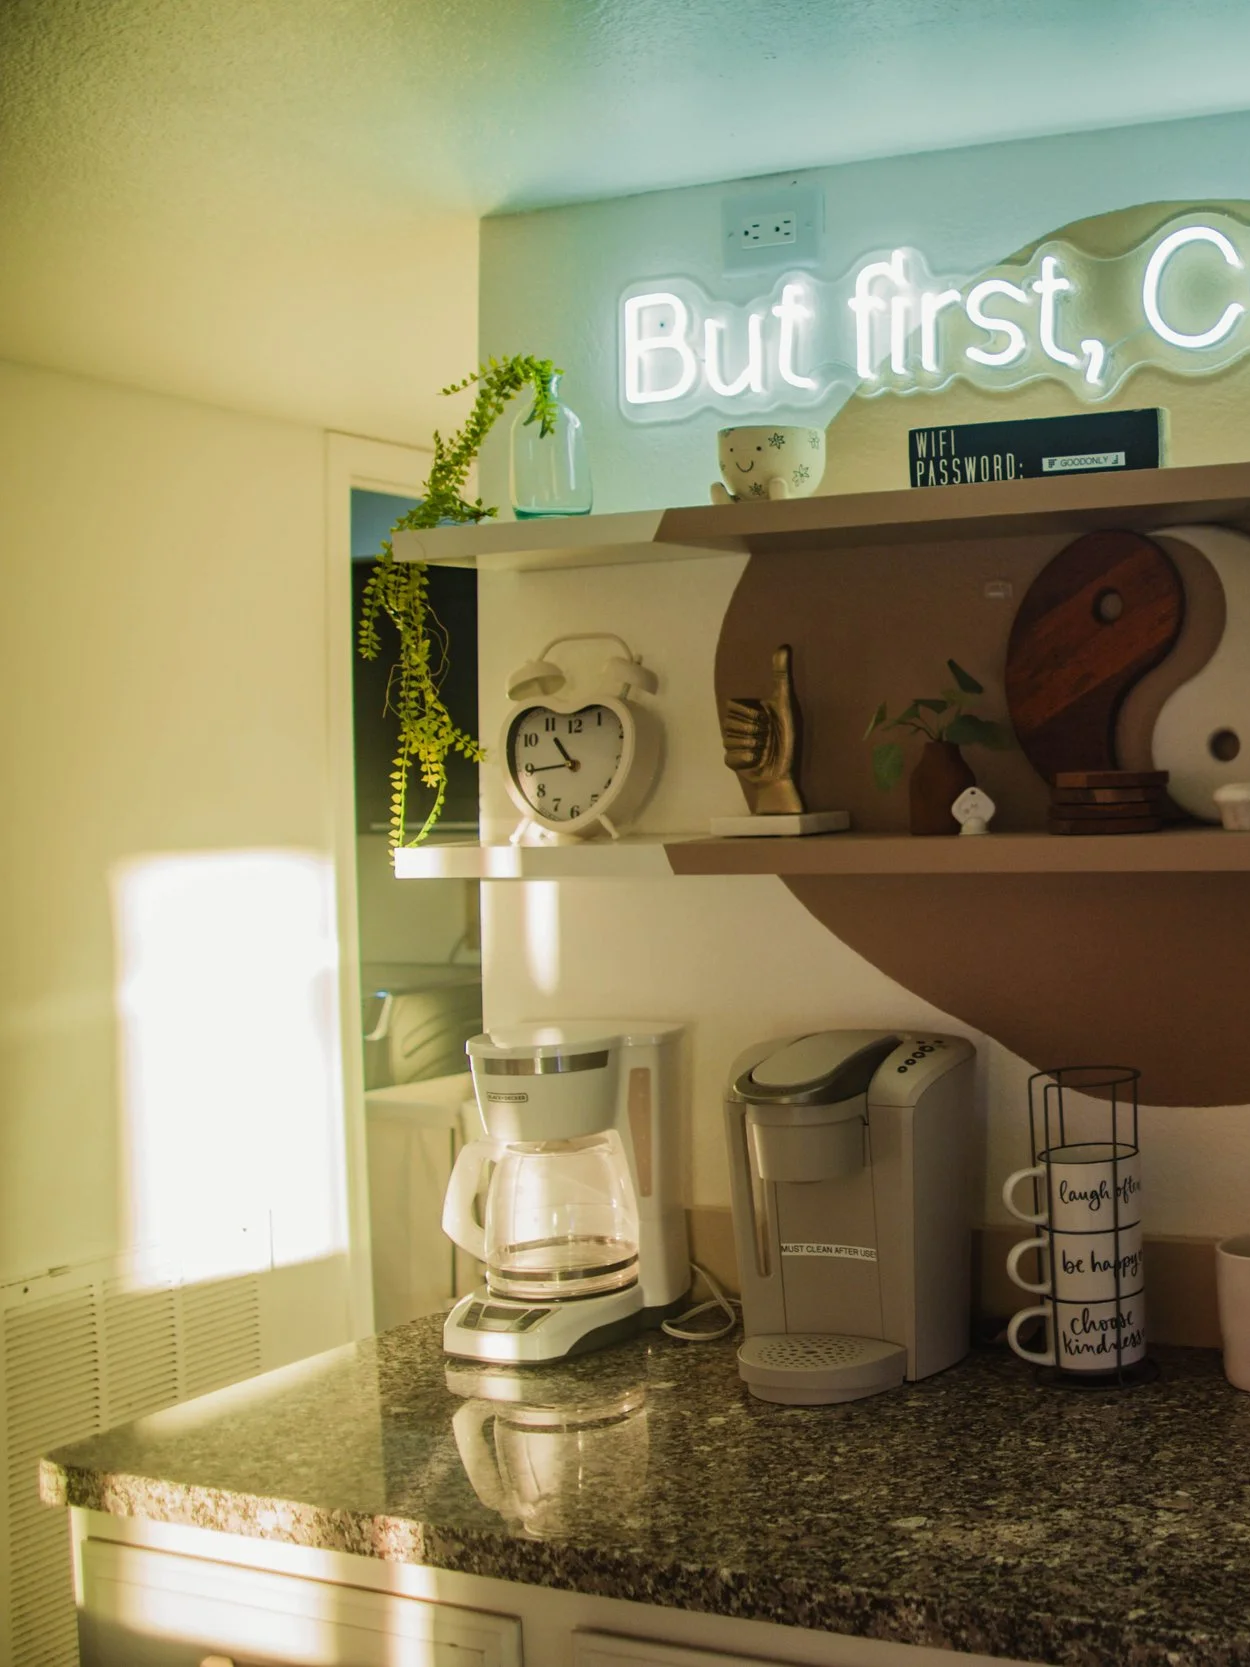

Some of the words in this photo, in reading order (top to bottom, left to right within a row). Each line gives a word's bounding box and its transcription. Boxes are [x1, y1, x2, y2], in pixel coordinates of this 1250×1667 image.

[624, 282, 818, 404] But
[849, 249, 1105, 386] first,
[916, 430, 955, 458] WIFI
[1060, 455, 1109, 468] GOODONLY
[916, 453, 1024, 487] PASSWORD:
[545, 717, 556, 732] 11
[568, 719, 583, 734] 12
[597, 711, 602, 727] 1
[524, 733, 539, 747] 10
[525, 763, 535, 777] 9
[536, 783, 546, 798] 8
[552, 798, 561, 812] 7
[570, 805, 580, 819] 6
[1060, 1180, 1111, 1211] laugh
[781, 1245, 804, 1253] MUST
[806, 1245, 833, 1254] CLEAN
[834, 1247, 859, 1256] AFTER
[1062, 1249, 1085, 1274] be
[1070, 1307, 1134, 1335] choose
